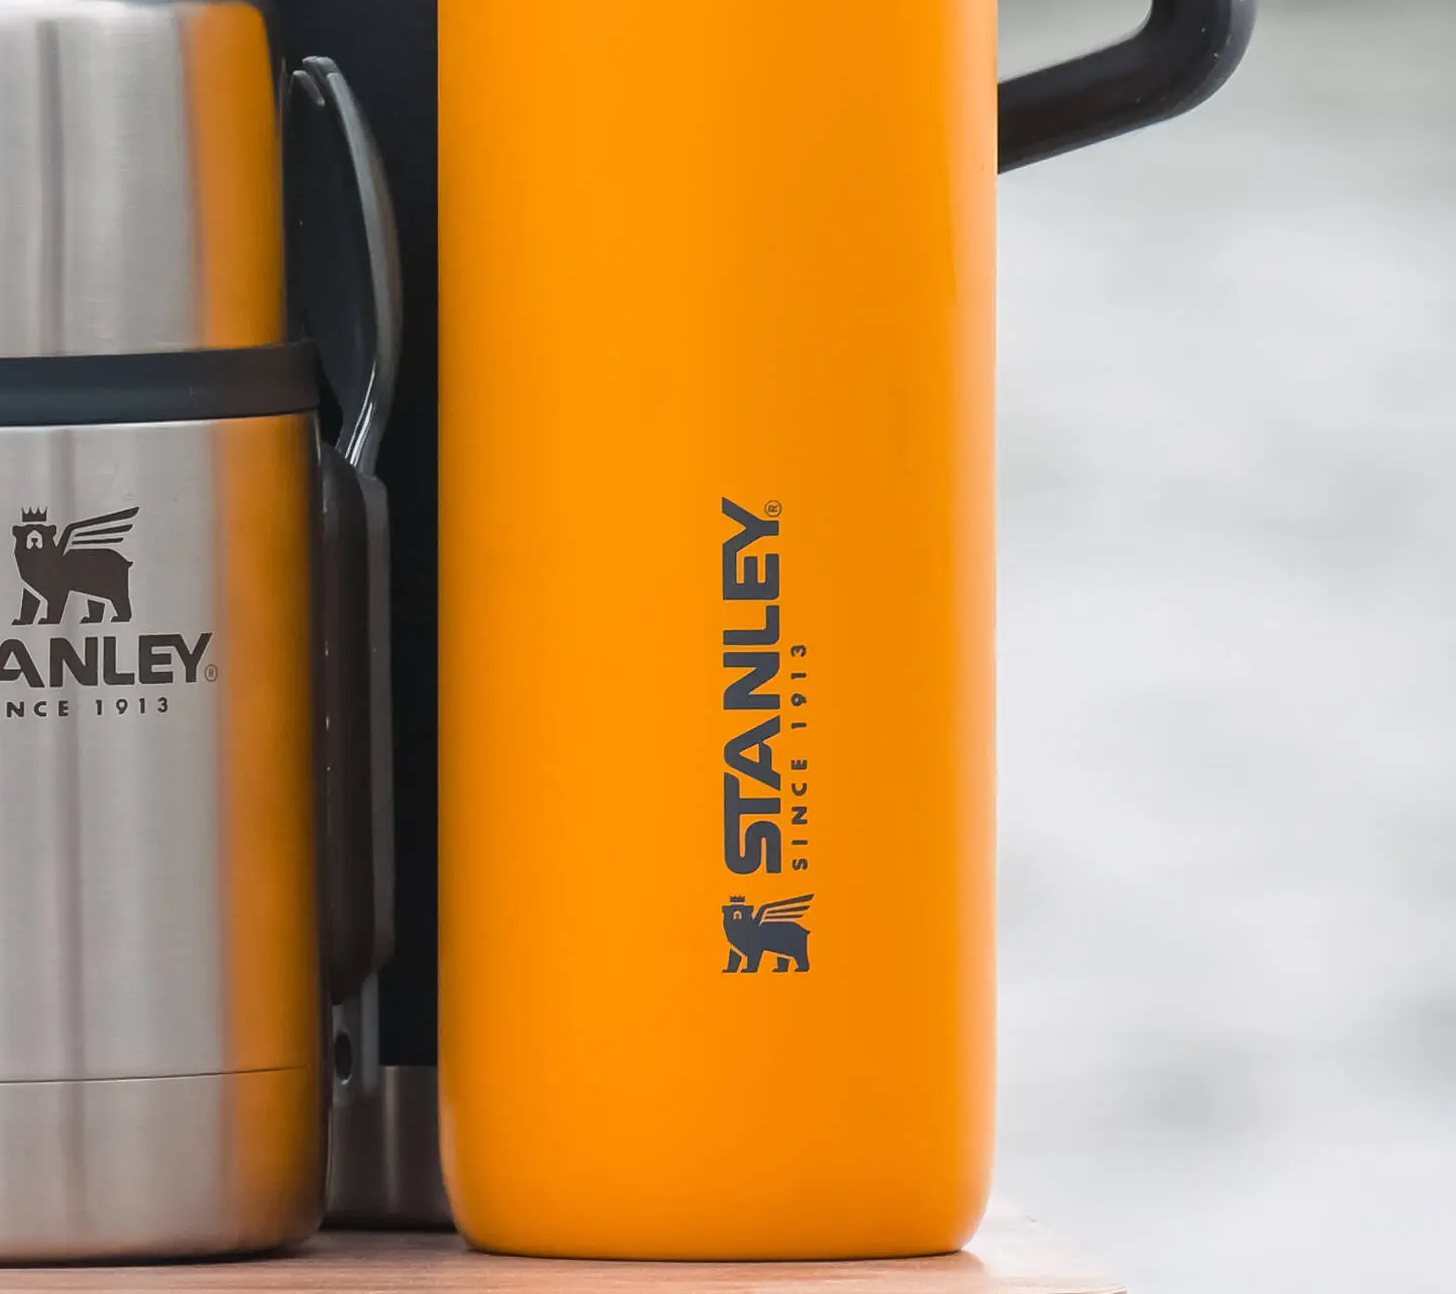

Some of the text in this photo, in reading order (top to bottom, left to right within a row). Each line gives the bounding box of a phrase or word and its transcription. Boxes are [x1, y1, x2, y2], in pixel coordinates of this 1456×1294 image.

[95, 696, 170, 716] 1913
[721, 496, 782, 875] STANLEY
[791, 643, 809, 871] SINCE 1913
